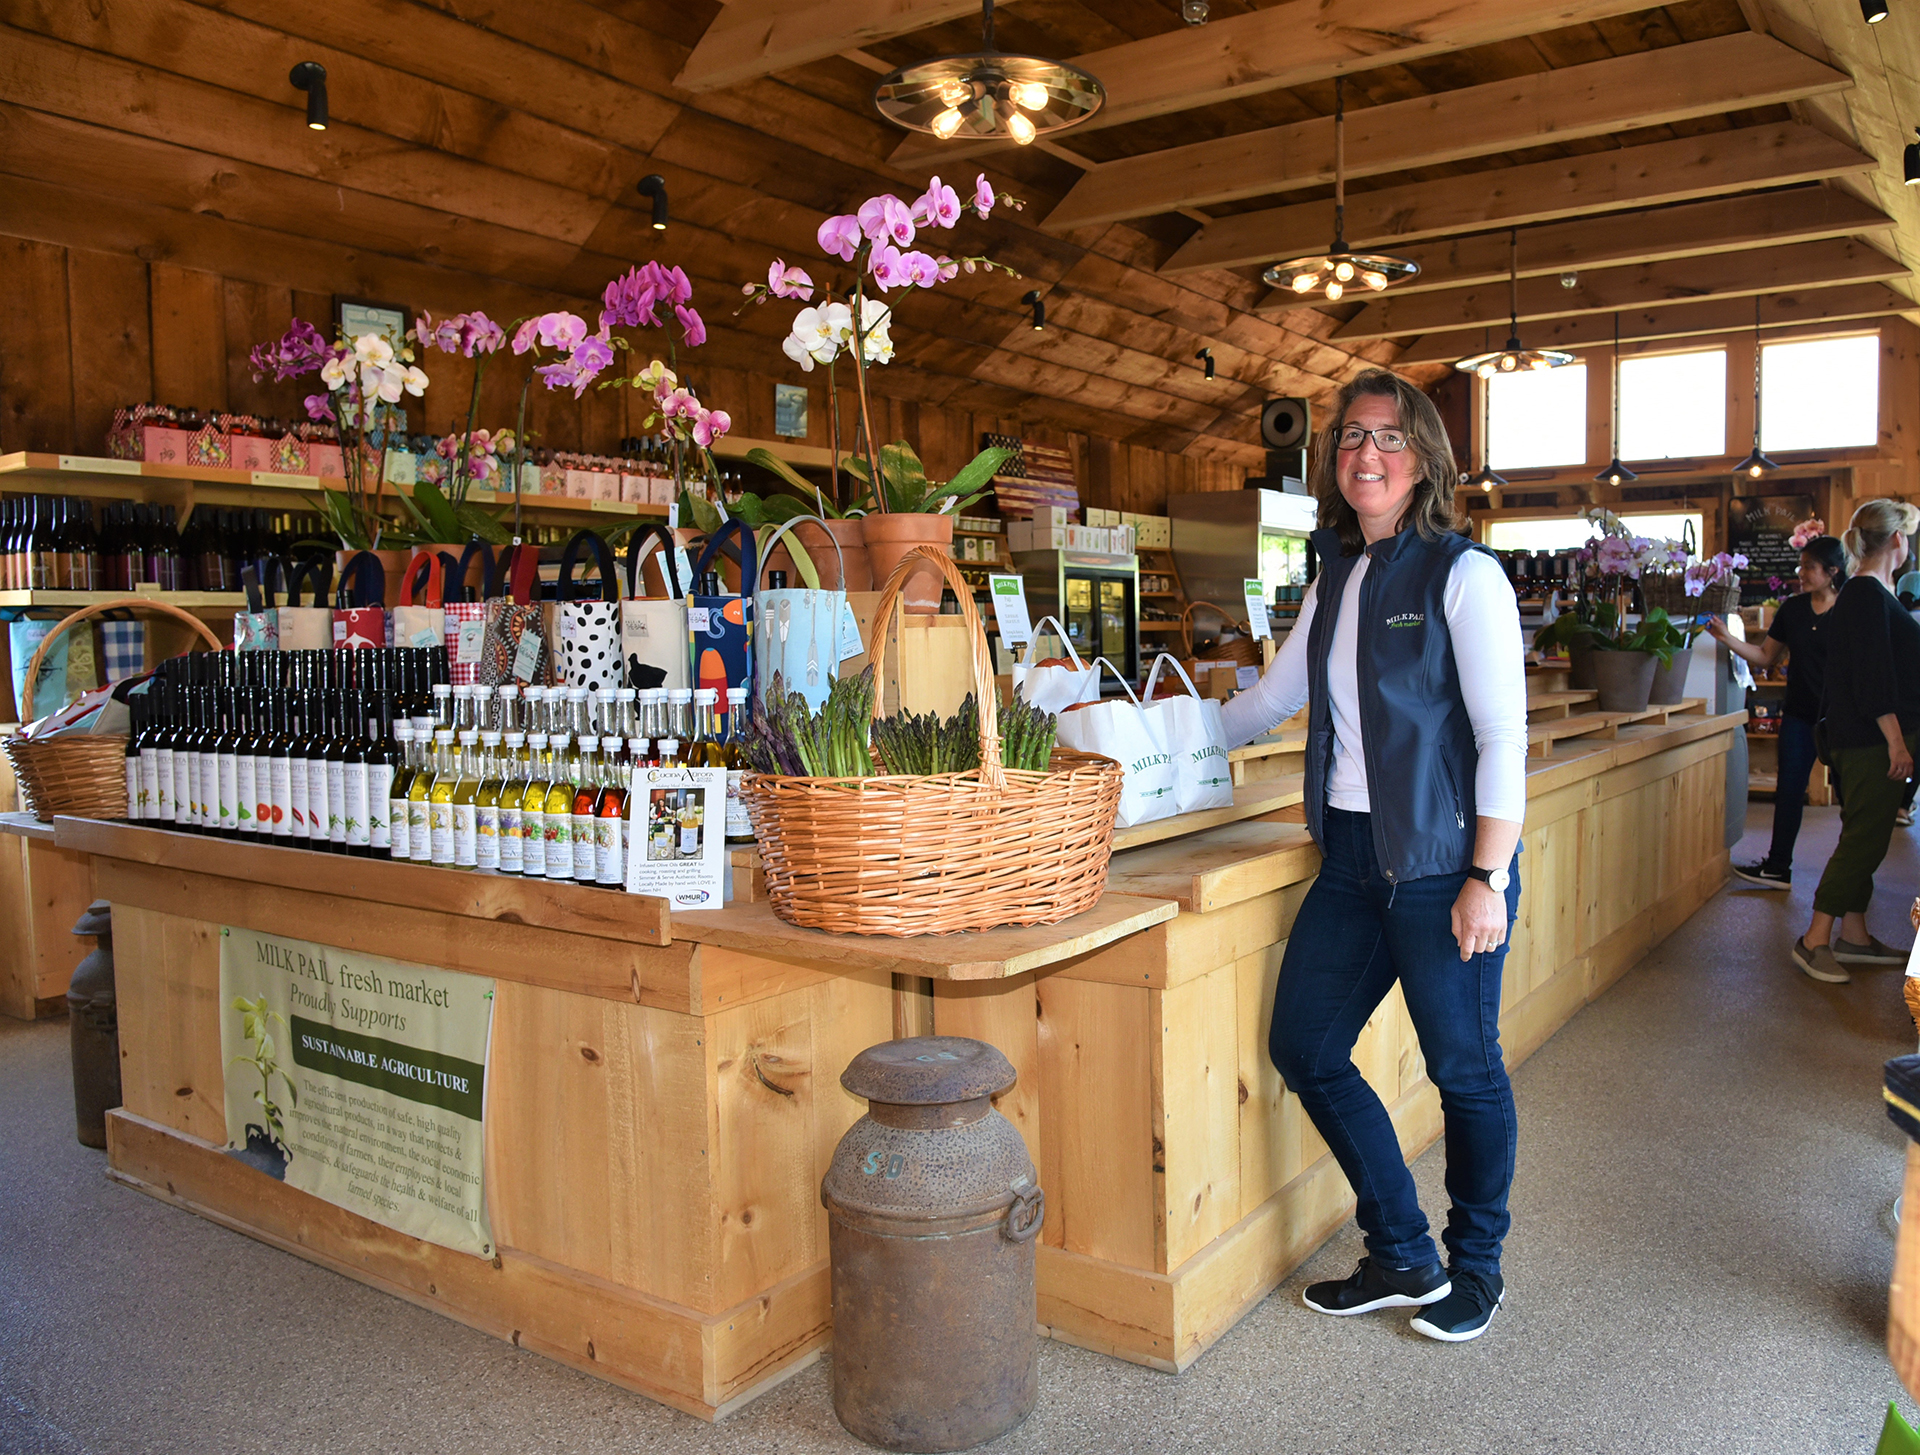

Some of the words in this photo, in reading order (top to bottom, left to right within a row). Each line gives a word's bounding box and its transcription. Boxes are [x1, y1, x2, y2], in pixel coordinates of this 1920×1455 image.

[1745, 508, 1770, 522] MILK
[1776, 507, 1796, 522] PAIL
[1386, 614, 1408, 626] MILK
[1132, 754, 1162, 774] MILK
[1162, 754, 1172, 764] PA
[1190, 746, 1214, 763] MILK
[1215, 746, 1228, 760] PAIL
[256, 940, 295, 973] MILK
[298, 953, 334, 985] PAIL
[339, 964, 383, 994] fresh
[388, 979, 449, 1008] market
[290, 983, 336, 1019] Proudly
[341, 998, 406, 1031] Supports
[302, 1034, 378, 1068] SUSTAINABLE
[381, 1057, 469, 1094] AGRICULTURE
[304, 1079, 316, 1093] The
[318, 1086, 347, 1102] efficient
[348, 1097, 387, 1116] production
[389, 1108, 396, 1119] of
[417, 1116, 435, 1132] high
[437, 1124, 461, 1144] quality
[304, 1098, 342, 1116] agricultural
[344, 1111, 375, 1130] products,
[377, 1120, 385, 1132] in
[386, 1125, 390, 1134] a
[392, 1127, 406, 1142] way
[409, 1131, 424, 1145] that
[455, 1147, 462, 1160] &
[289, 1106, 320, 1126] improves
[322, 1118, 332, 1130] the
[334, 1124, 358, 1139] natural
[360, 1134, 407, 1157] environment,
[409, 1148, 419, 1161] the
[421, 1155, 440, 1170] social
[442, 1163, 480, 1185] economic
[302, 1130, 338, 1149] conditions
[339, 1142, 346, 1153] of
[346, 1144, 376, 1165] farmers,
[378, 1155, 395, 1170] their
[395, 1166, 435, 1186] employees
[436, 1179, 442, 1190] &
[444, 1180, 462, 1198] local
[334, 1157, 340, 1168] &
[341, 1162, 379, 1183] safeguards
[380, 1174, 390, 1188] the
[391, 1179, 416, 1197] health
[418, 1189, 426, 1201] &
[428, 1194, 455, 1213] welfare
[456, 1206, 465, 1218] of
[465, 1209, 477, 1222] all
[347, 1180, 373, 1200] farmed
[373, 1194, 400, 1212] species.
